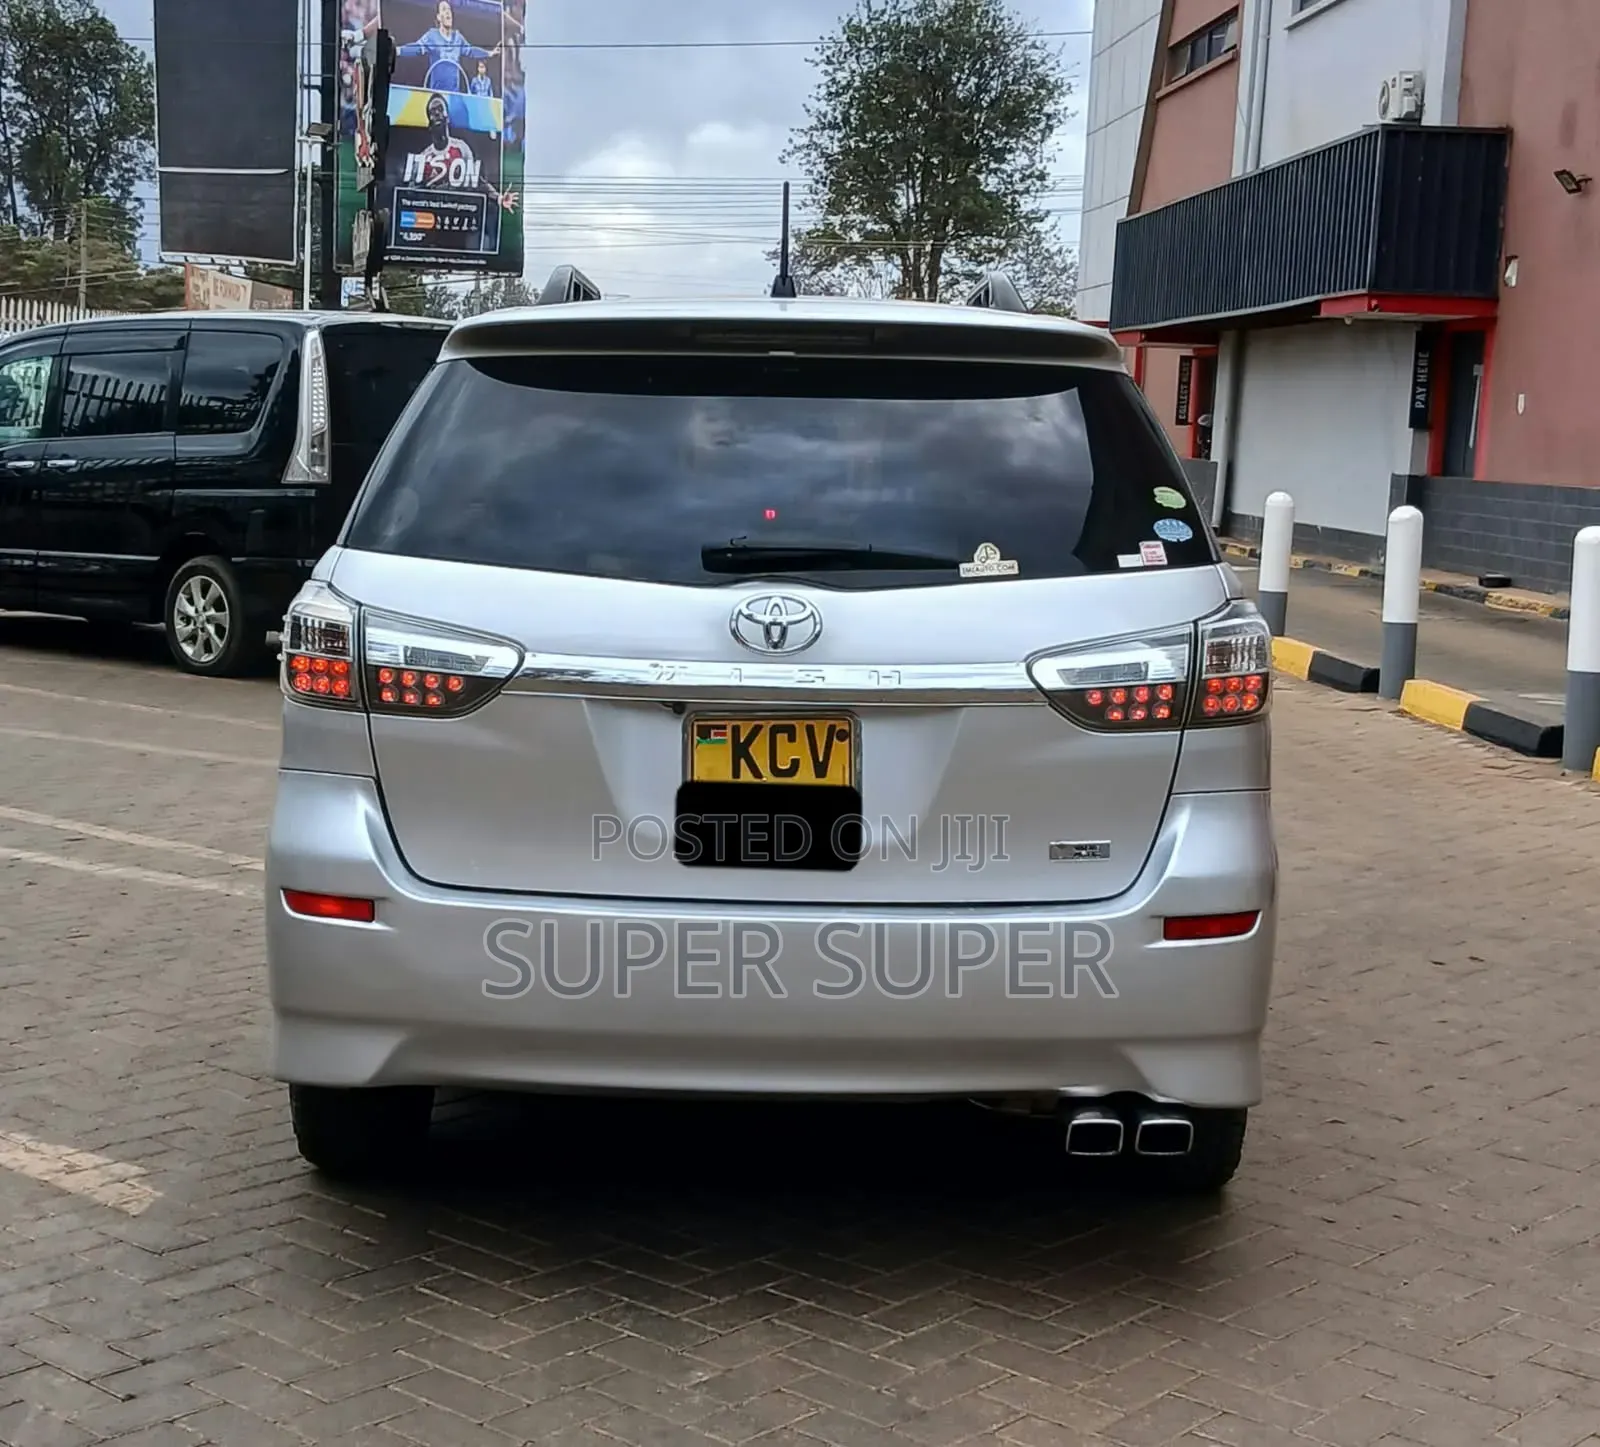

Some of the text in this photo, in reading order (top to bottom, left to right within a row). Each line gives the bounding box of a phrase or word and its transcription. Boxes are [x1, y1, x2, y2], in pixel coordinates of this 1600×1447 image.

[449, 159, 481, 188] ON
[1415, 386, 1428, 409] PAY
[731, 723, 838, 780] KCV
